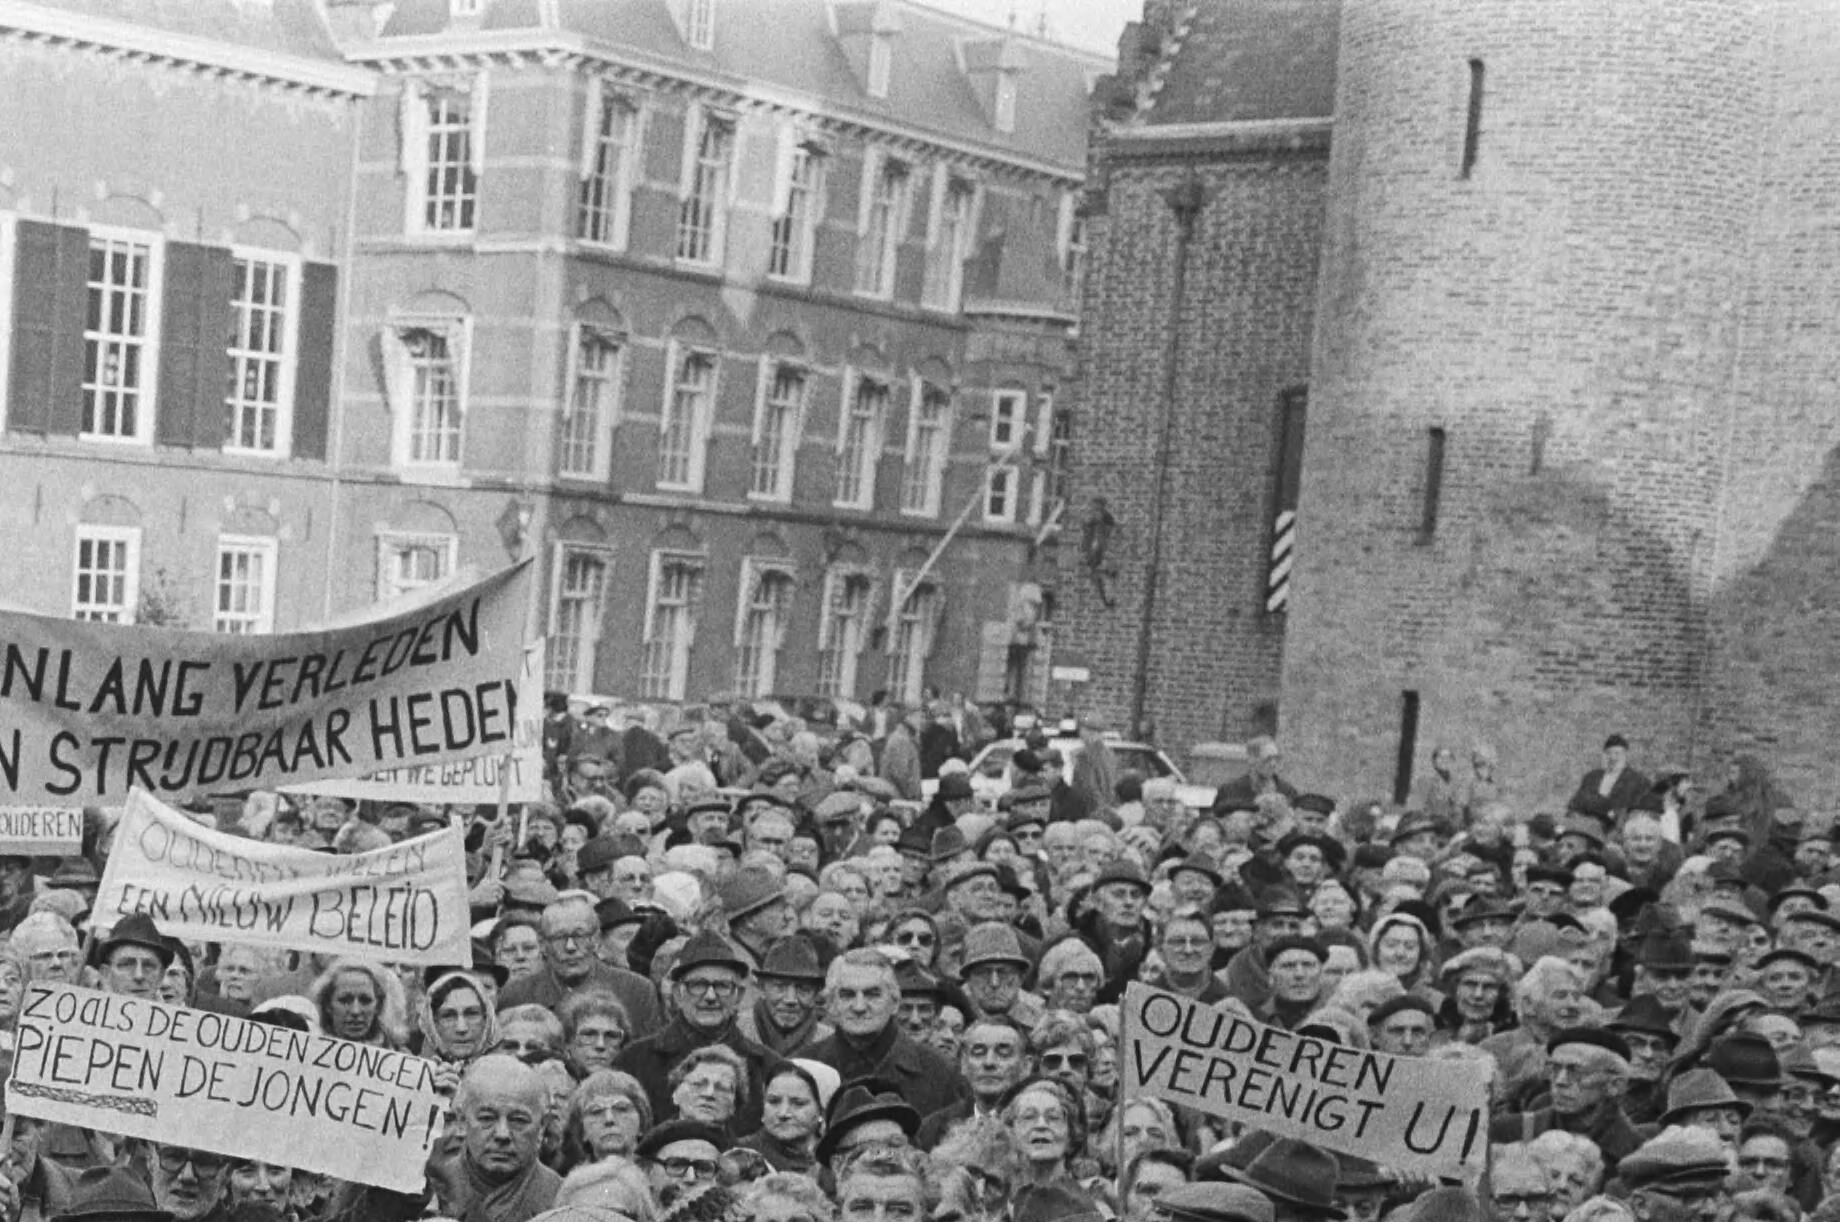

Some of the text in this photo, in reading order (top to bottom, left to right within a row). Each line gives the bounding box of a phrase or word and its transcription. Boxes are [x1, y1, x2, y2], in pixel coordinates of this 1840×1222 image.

[233, 597, 482, 714] VERLEDEN
[145, 1005, 189, 1042] DE
[196, 1013, 311, 1064] OUDEN
[312, 1038, 438, 1095] ZONGEN
[174, 1055, 237, 1103] DE
[1133, 1039, 1386, 1138] VERENIGT
[1140, 993, 1395, 1096] OUDEREN
